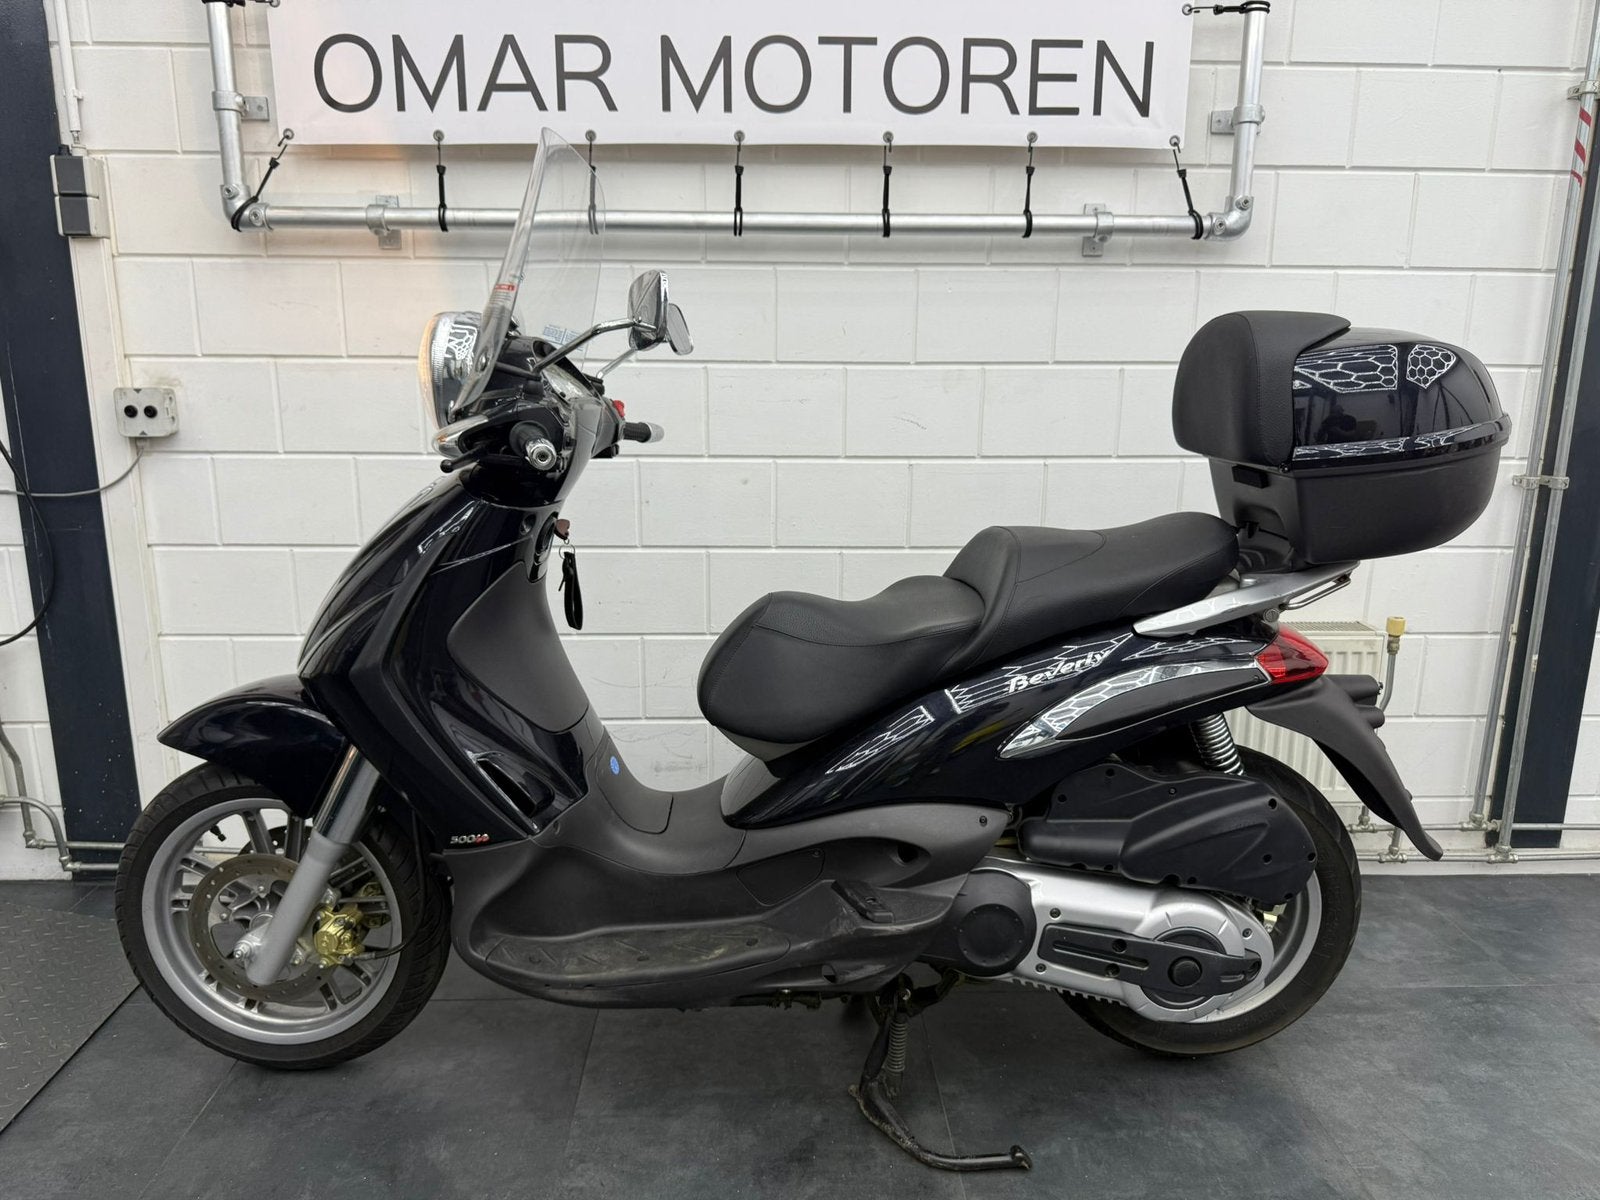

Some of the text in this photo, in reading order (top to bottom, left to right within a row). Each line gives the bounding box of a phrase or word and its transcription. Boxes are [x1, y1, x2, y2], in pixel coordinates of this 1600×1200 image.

[313, 33, 1155, 118] OMAR MOTOREN
[1008, 649, 1111, 693] Beverly
